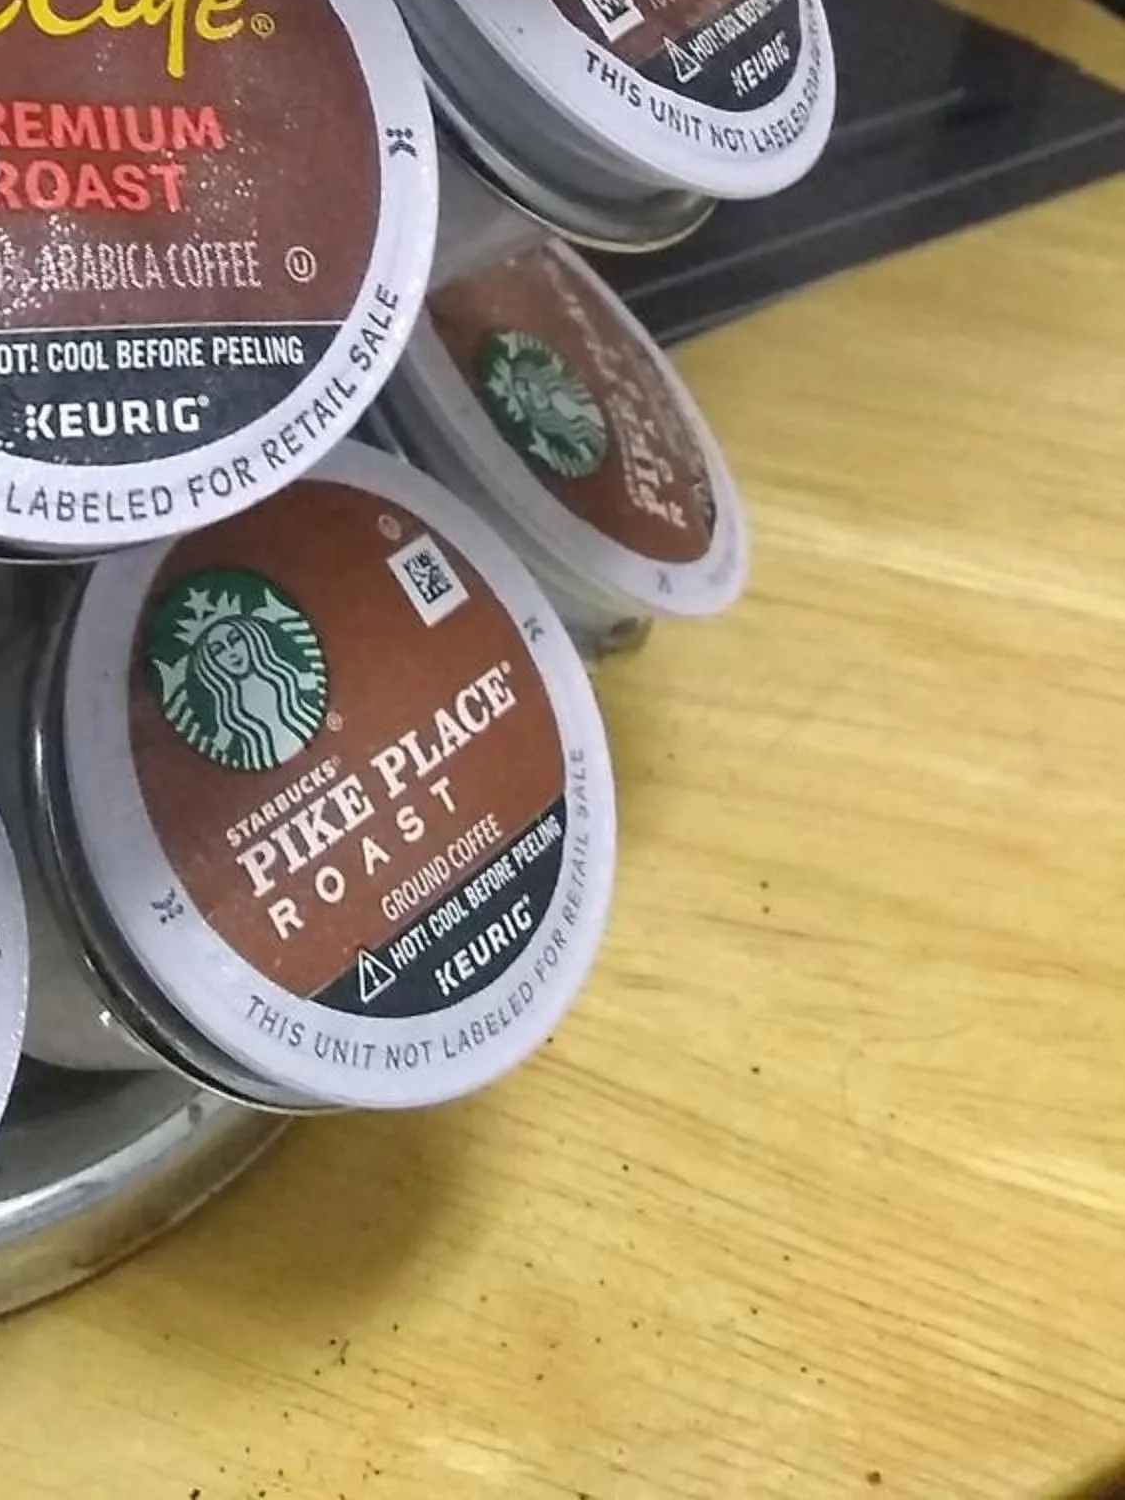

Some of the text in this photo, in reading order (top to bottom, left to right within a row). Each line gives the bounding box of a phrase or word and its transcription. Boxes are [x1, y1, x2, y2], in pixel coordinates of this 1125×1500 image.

[584, 48, 643, 108] THIS
[650, 100, 704, 142] UNIT
[709, 123, 747, 152] NOT
[753, 100, 808, 155] LABELED
[730, 36, 791, 98] KEURIG
[39, 242, 161, 293] ARABICA
[165, 240, 265, 291] COFFEE
[5, 485, 174, 525] LABELED
[186, 457, 256, 509] FOR
[265, 372, 360, 467] RETAIL
[351, 282, 401, 372] SALE
[47, 339, 110, 372] COOL
[117, 335, 206, 370] BEFORE
[212, 334, 304, 368] PEELING
[24, 397, 201, 441] KEURIG
[225, 755, 340, 850] STARBUCKS
[234, 664, 518, 899] PIKE PLACE
[245, 747, 592, 1070] THIS UNIT NOT LABELED FOR RETAIL SALE
[266, 778, 460, 941] ROAST
[380, 812, 505, 924] GROUND COFFEE
[388, 813, 563, 972] HOT! COOL BEFORE PEELING
[435, 910, 534, 997] KEURIG
